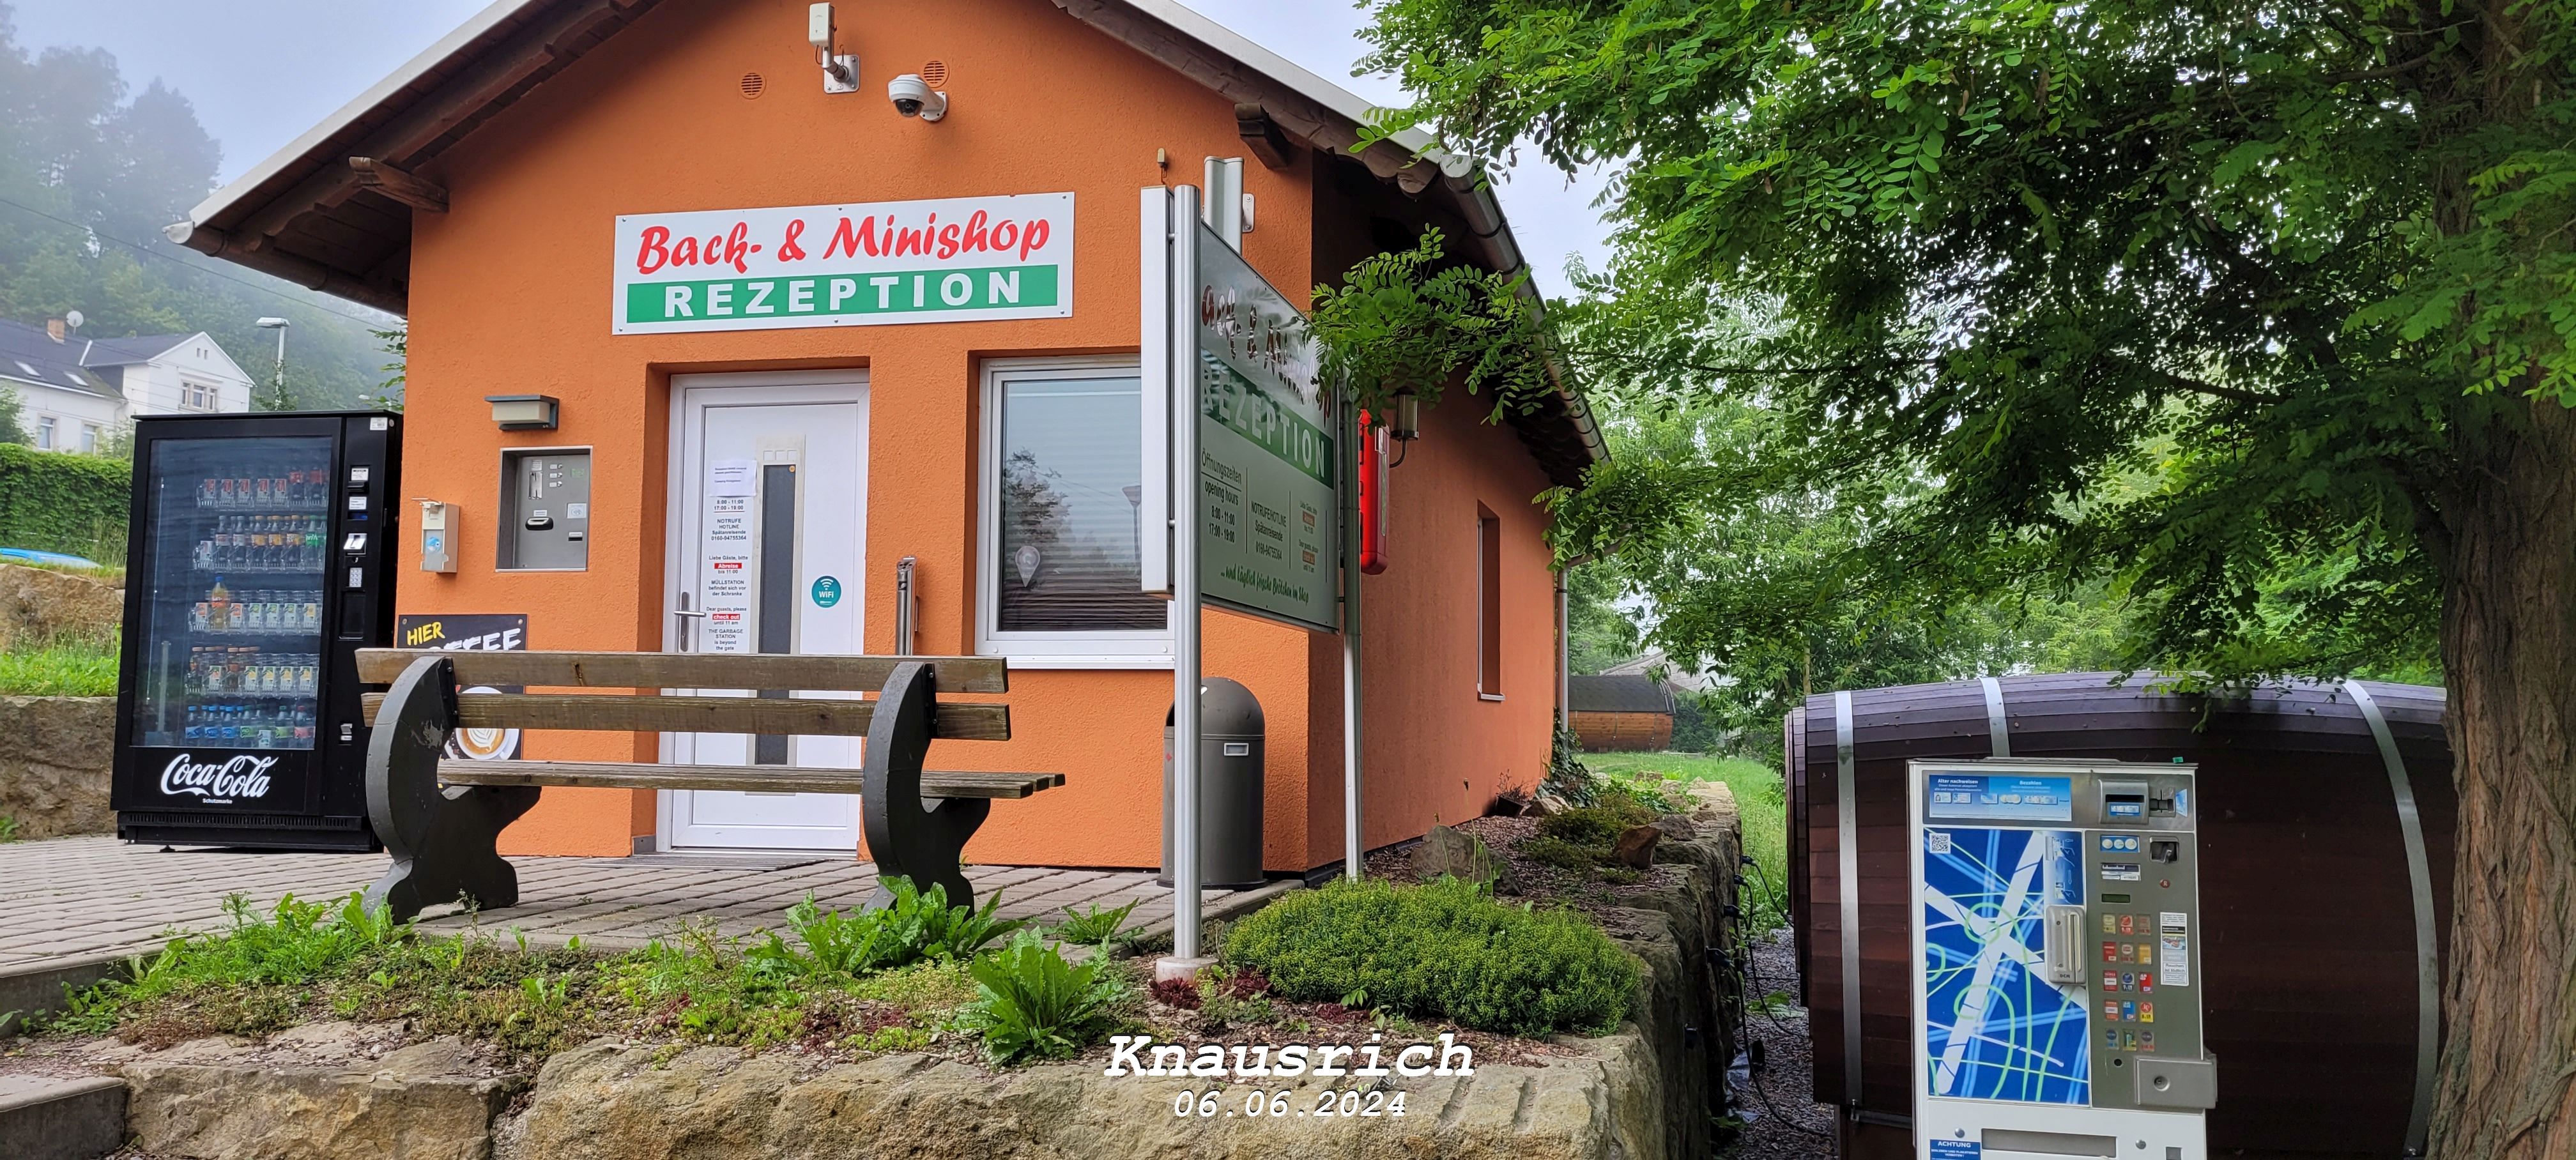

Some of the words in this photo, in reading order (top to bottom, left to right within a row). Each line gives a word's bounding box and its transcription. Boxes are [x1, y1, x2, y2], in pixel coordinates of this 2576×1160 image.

[637, 221, 762, 274] Back-
[778, 219, 807, 262] &
[823, 210, 1050, 262] Minishop
[665, 271, 1020, 318] REZEPTION
[1202, 360, 1325, 478] REZEPTION
[1202, 448, 1242, 485] Öffnungszeiten
[1205, 480, 1225, 503] opening
[1225, 487, 1239, 506] hours
[1209, 523, 1220, 538] 17:00
[1223, 528, 1235, 543] 19:00
[1211, 505, 1221, 520] 8:00
[1224, 511, 1235, 526] 11:00
[407, 622, 446, 646] HIER
[160, 753, 279, 798] Coca-Cola
